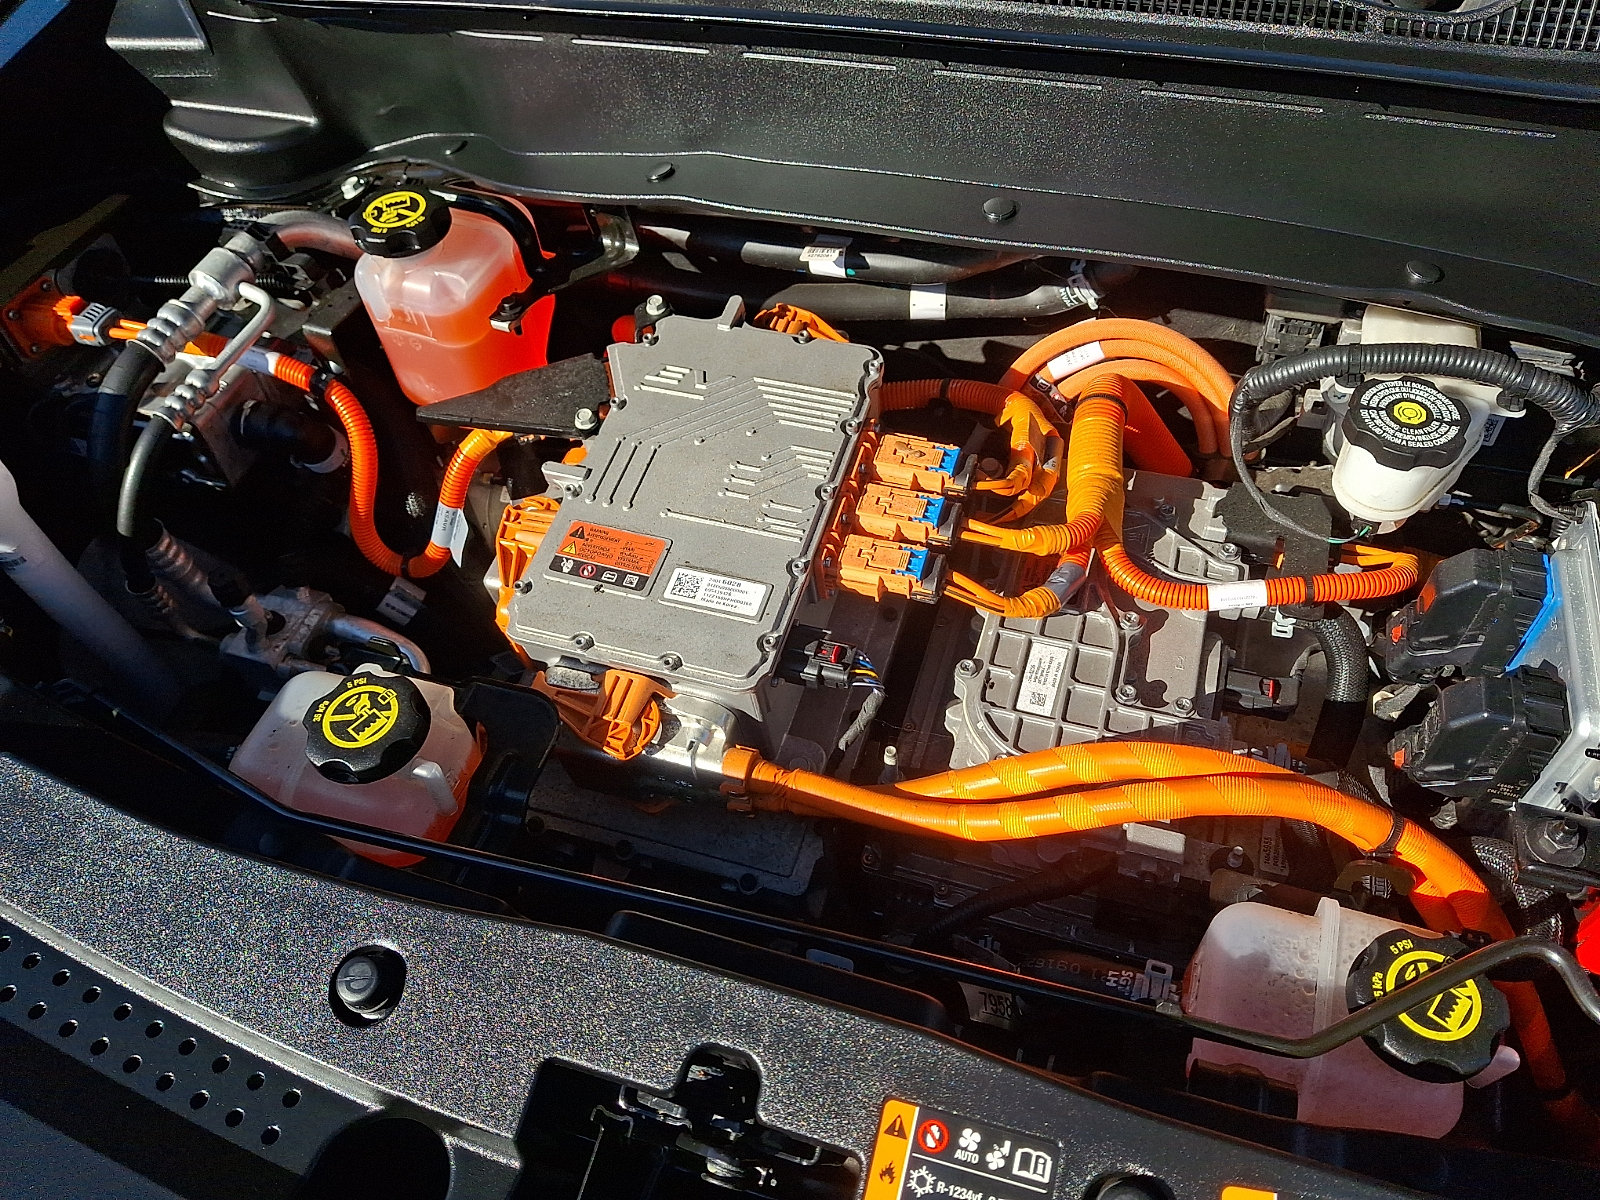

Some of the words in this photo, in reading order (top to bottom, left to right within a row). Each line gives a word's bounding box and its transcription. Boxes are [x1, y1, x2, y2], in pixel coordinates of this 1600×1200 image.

[1365, 421, 1384, 435] FLUID
[1380, 432, 1401, 444] FROM
[1373, 418, 1396, 435] BEFORE
[354, 677, 367, 687] PSI
[313, 713, 322, 723] 35
[318, 700, 330, 714] kPa
[1389, 944, 1398, 955] 5
[1396, 938, 1414, 952] PSI
[1371, 971, 1384, 990] kPa
[954, 1149, 980, 1165] AUTO
